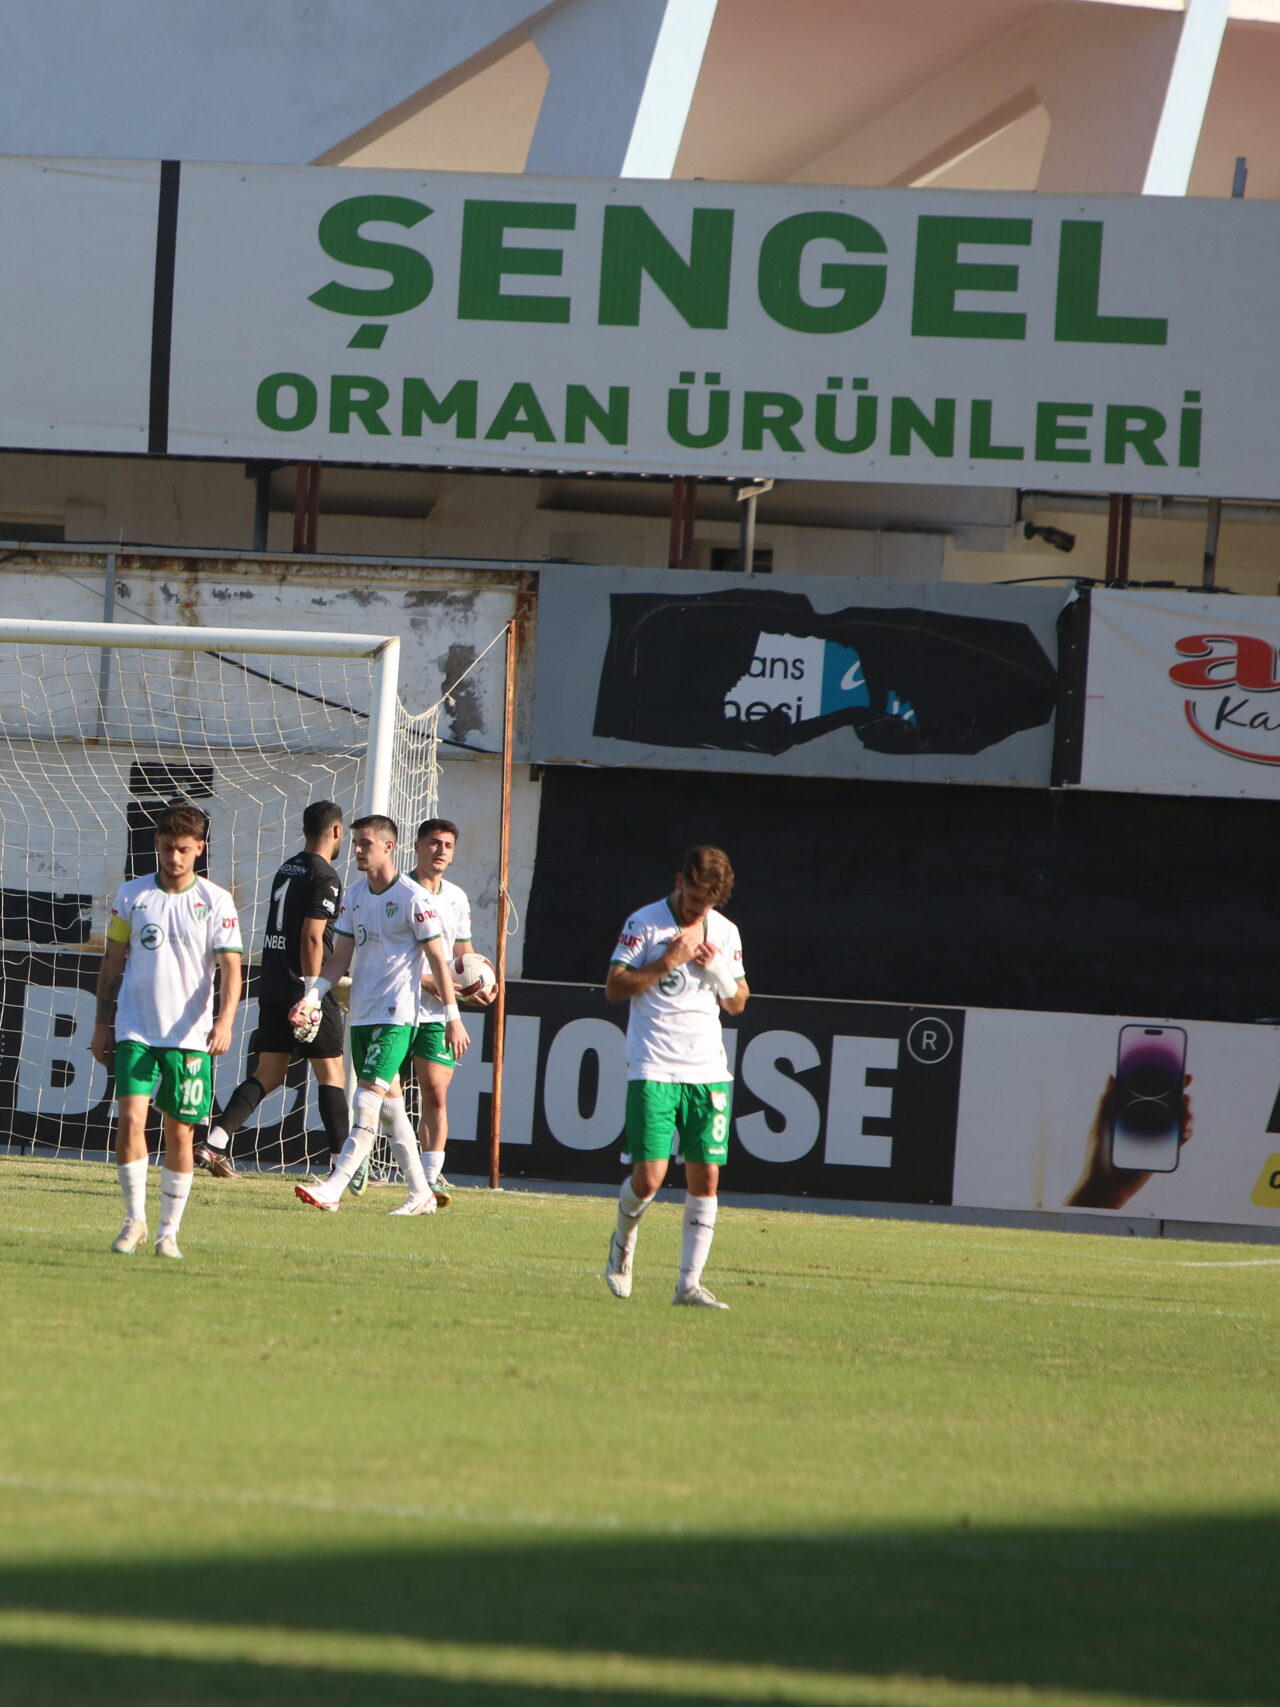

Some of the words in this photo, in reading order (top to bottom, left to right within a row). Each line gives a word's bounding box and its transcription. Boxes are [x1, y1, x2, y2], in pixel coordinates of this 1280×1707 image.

[307, 194, 1168, 349] ŞENGEL
[256, 372, 630, 446] ORMAN
[667, 371, 1203, 468] ÜRÜNLERİ
[273, 877, 292, 931] 1
[179, 1078, 203, 1106] 10
[442, 1012, 900, 1168] HOSE
[712, 1113, 727, 1143] 8
